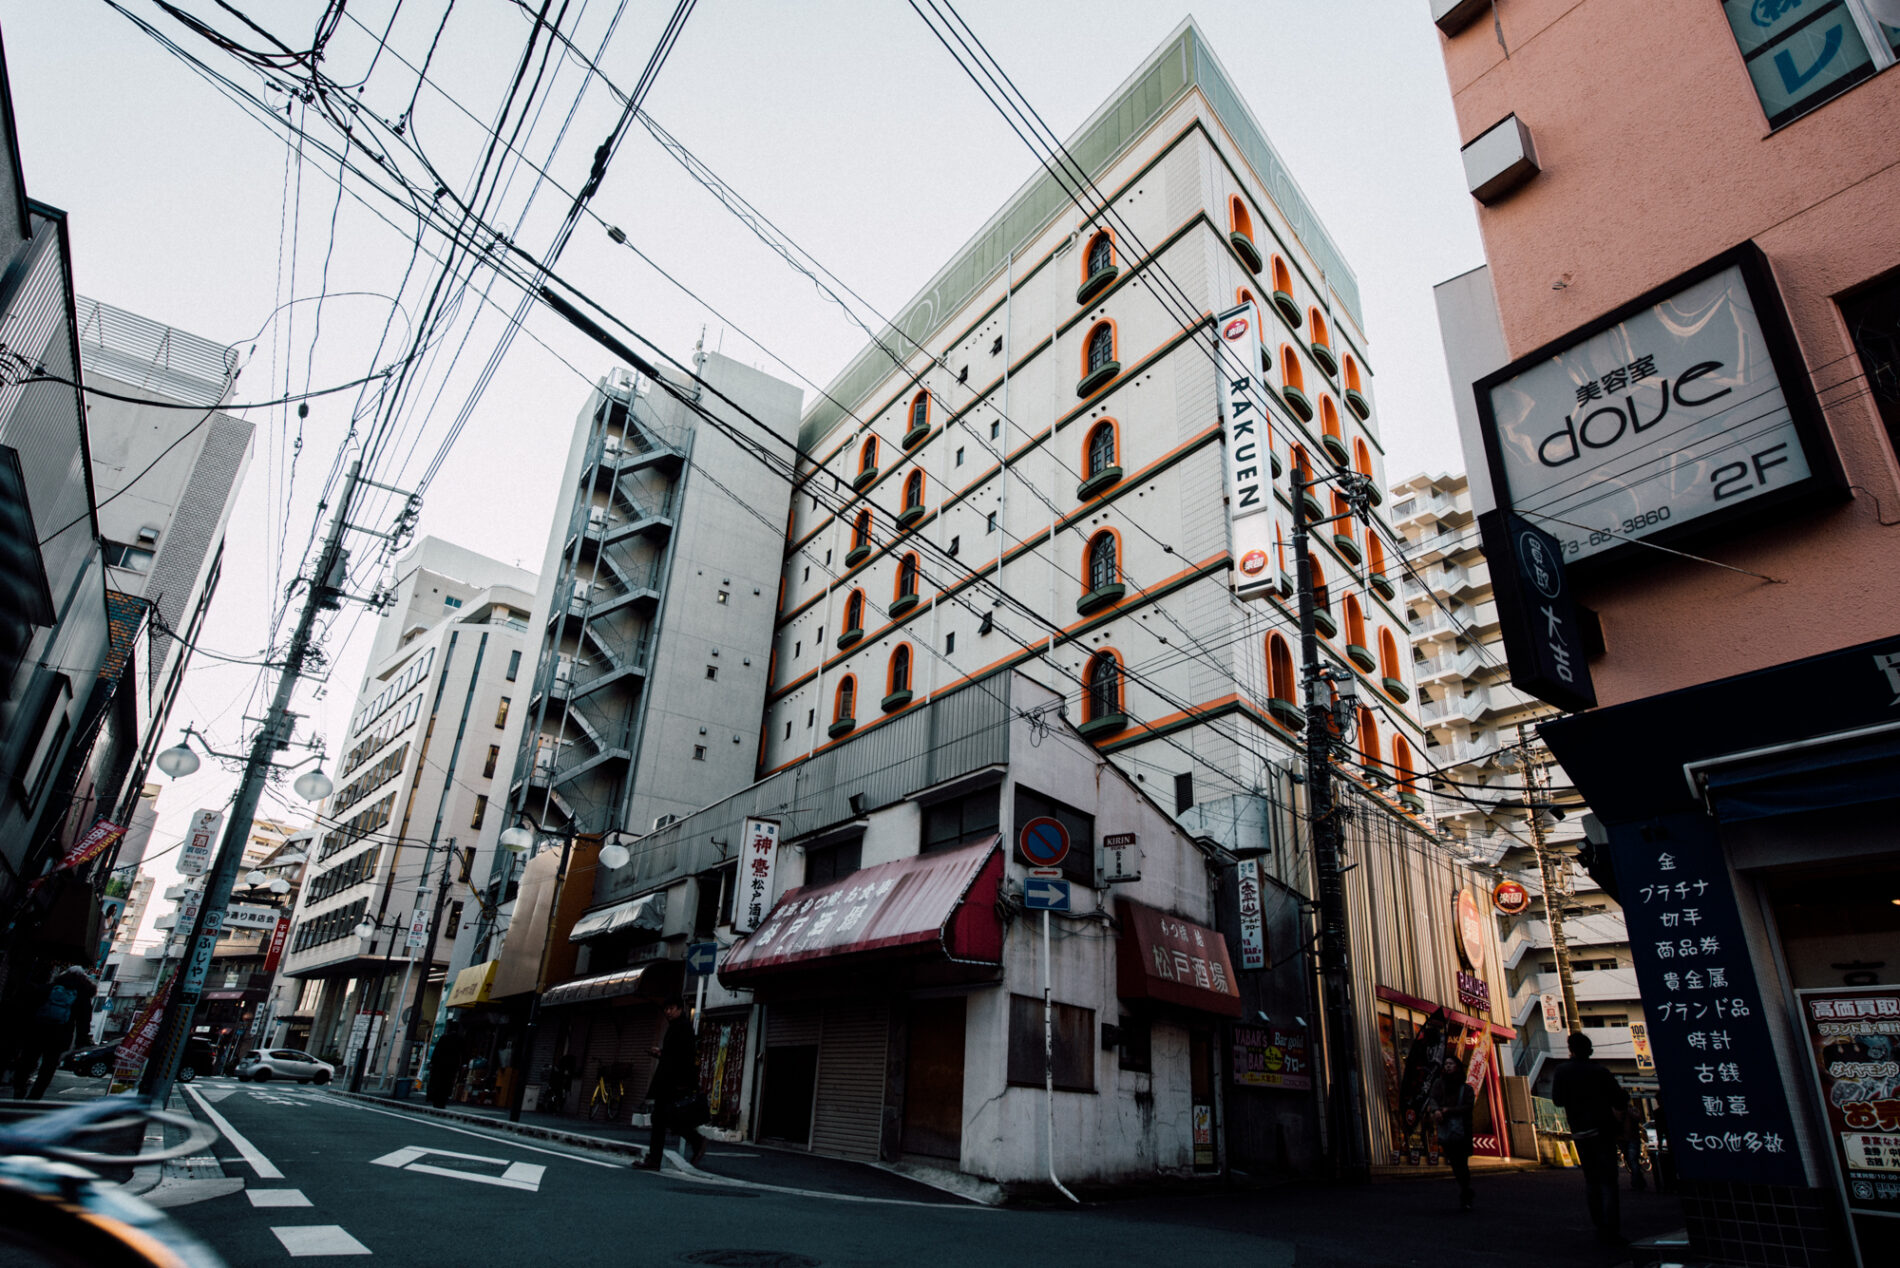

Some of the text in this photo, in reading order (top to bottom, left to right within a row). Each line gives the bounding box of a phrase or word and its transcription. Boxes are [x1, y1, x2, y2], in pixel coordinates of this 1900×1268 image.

[1575, 354, 1659, 408] 美容室
[1230, 376, 1260, 508] RAKUEN
[1710, 442, 1787, 501] 2F
[1527, 536, 1553, 593] 買取
[1541, 604, 1574, 682] 大吉
[1106, 835, 1130, 845] KIRIN
[1658, 852, 1677, 871] 金
[1640, 879, 1709, 904] プラチナ
[747, 878, 766, 930] 松戸酒場
[1660, 907, 1702, 928] 切手
[191, 937, 210, 976] ふじや
[1655, 936, 1720, 959] 商品券
[1152, 943, 1230, 994] 松戸酒場
[1663, 967, 1729, 991] 貴金属
[1657, 998, 1750, 1021] ブランド品
[1630, 1025, 1645, 1034] 100
[1687, 1029, 1731, 1051] 時計
[1694, 1062, 1743, 1083] 古銭
[1702, 1095, 1750, 1117] 勲章
[1686, 1131, 1785, 1153] その他多数
